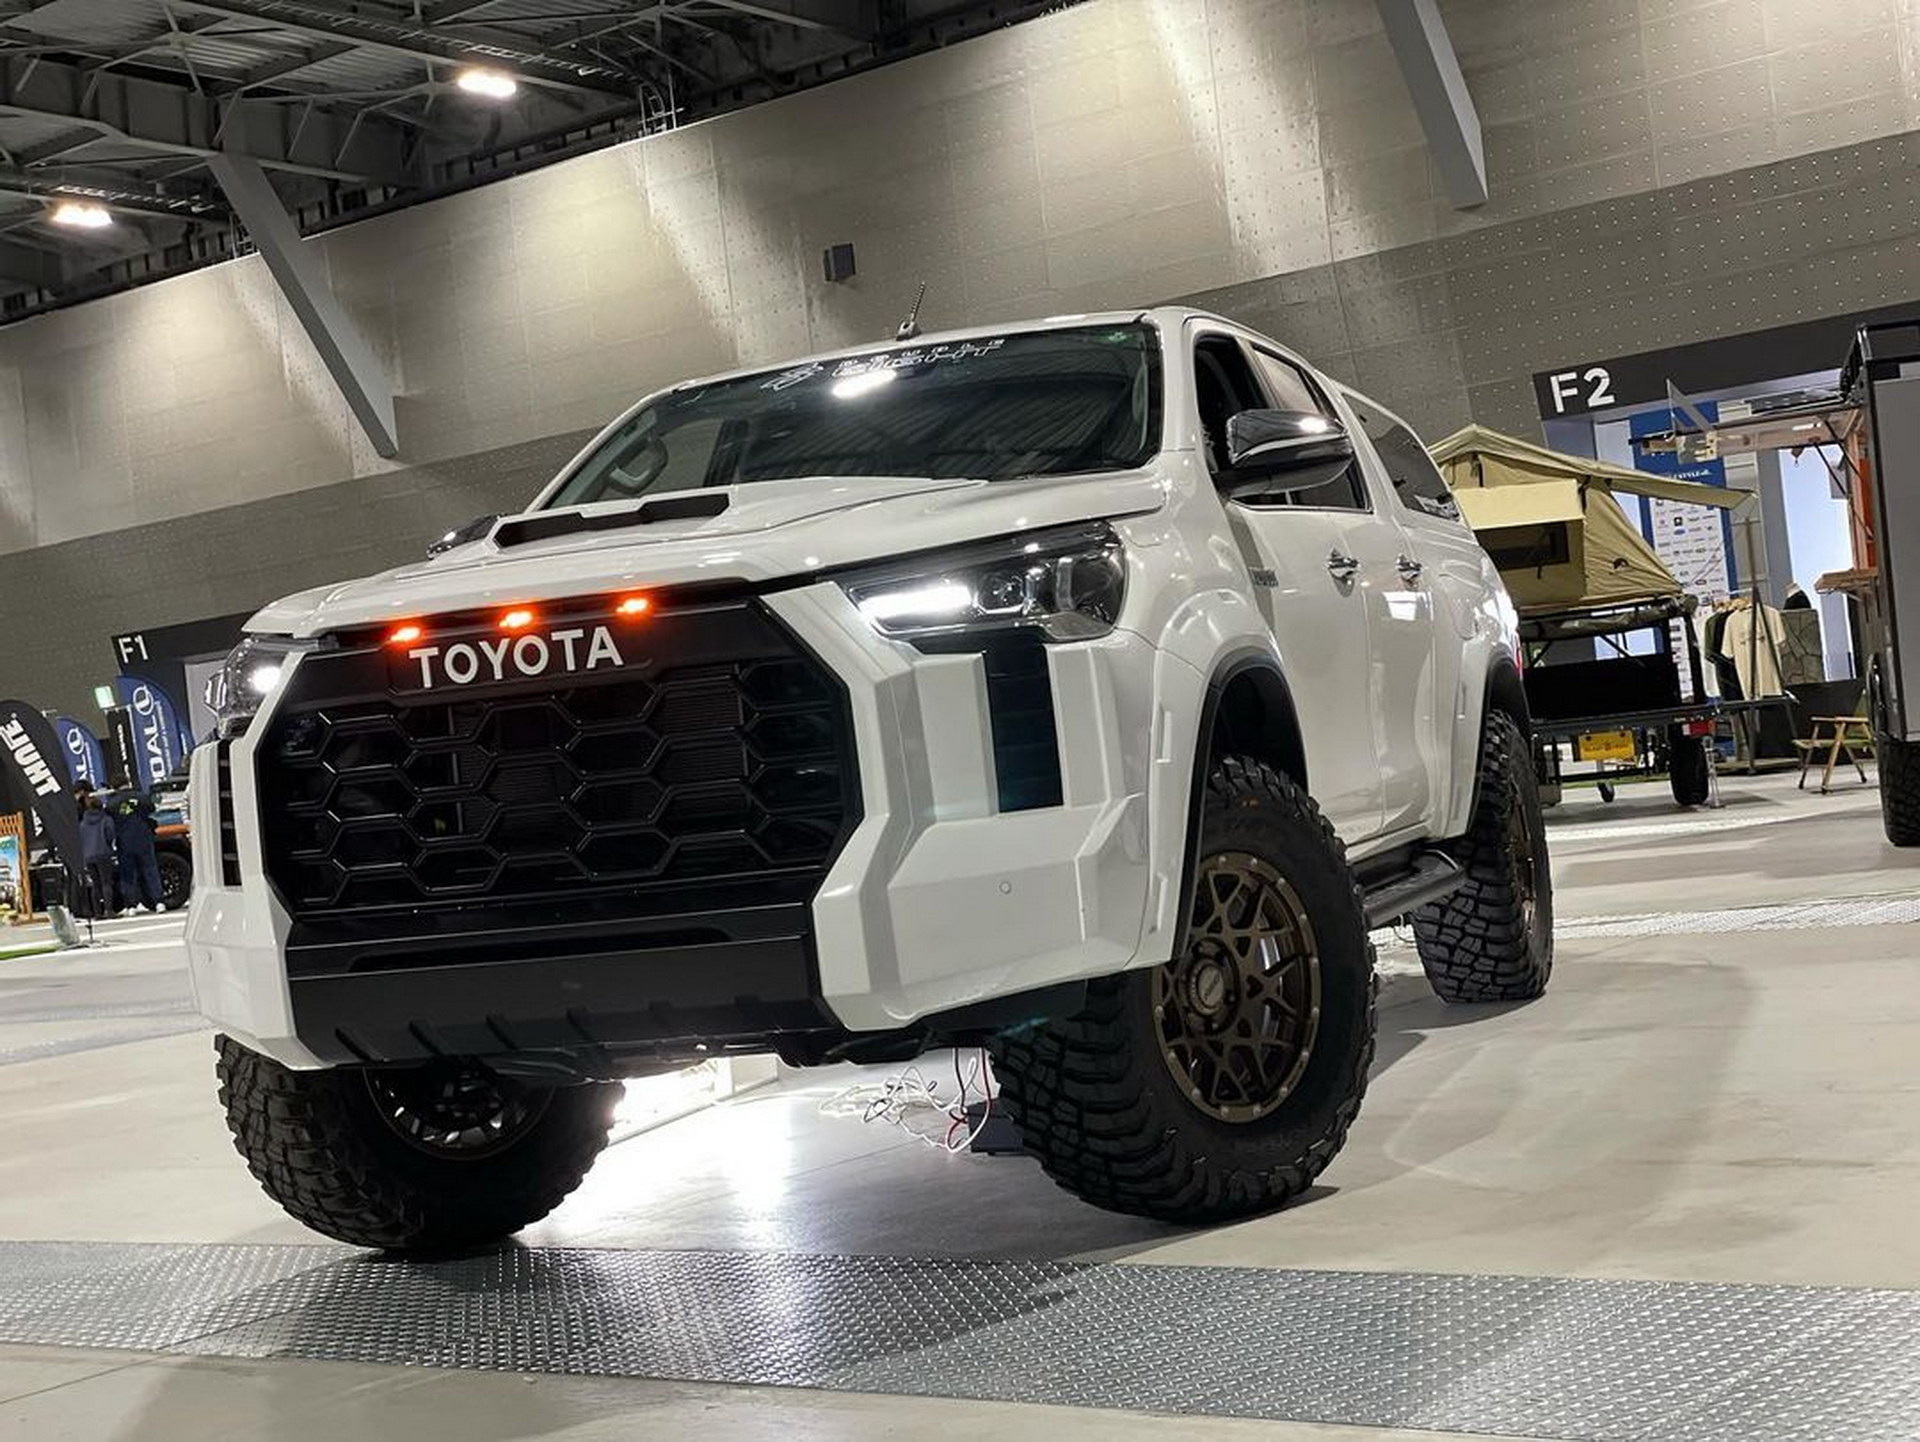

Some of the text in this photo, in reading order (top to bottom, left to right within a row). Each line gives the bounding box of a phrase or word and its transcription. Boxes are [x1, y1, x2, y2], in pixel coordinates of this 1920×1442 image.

[1549, 367, 1616, 413] F2
[118, 634, 149, 664] F1
[409, 625, 624, 689] TOYOTA
